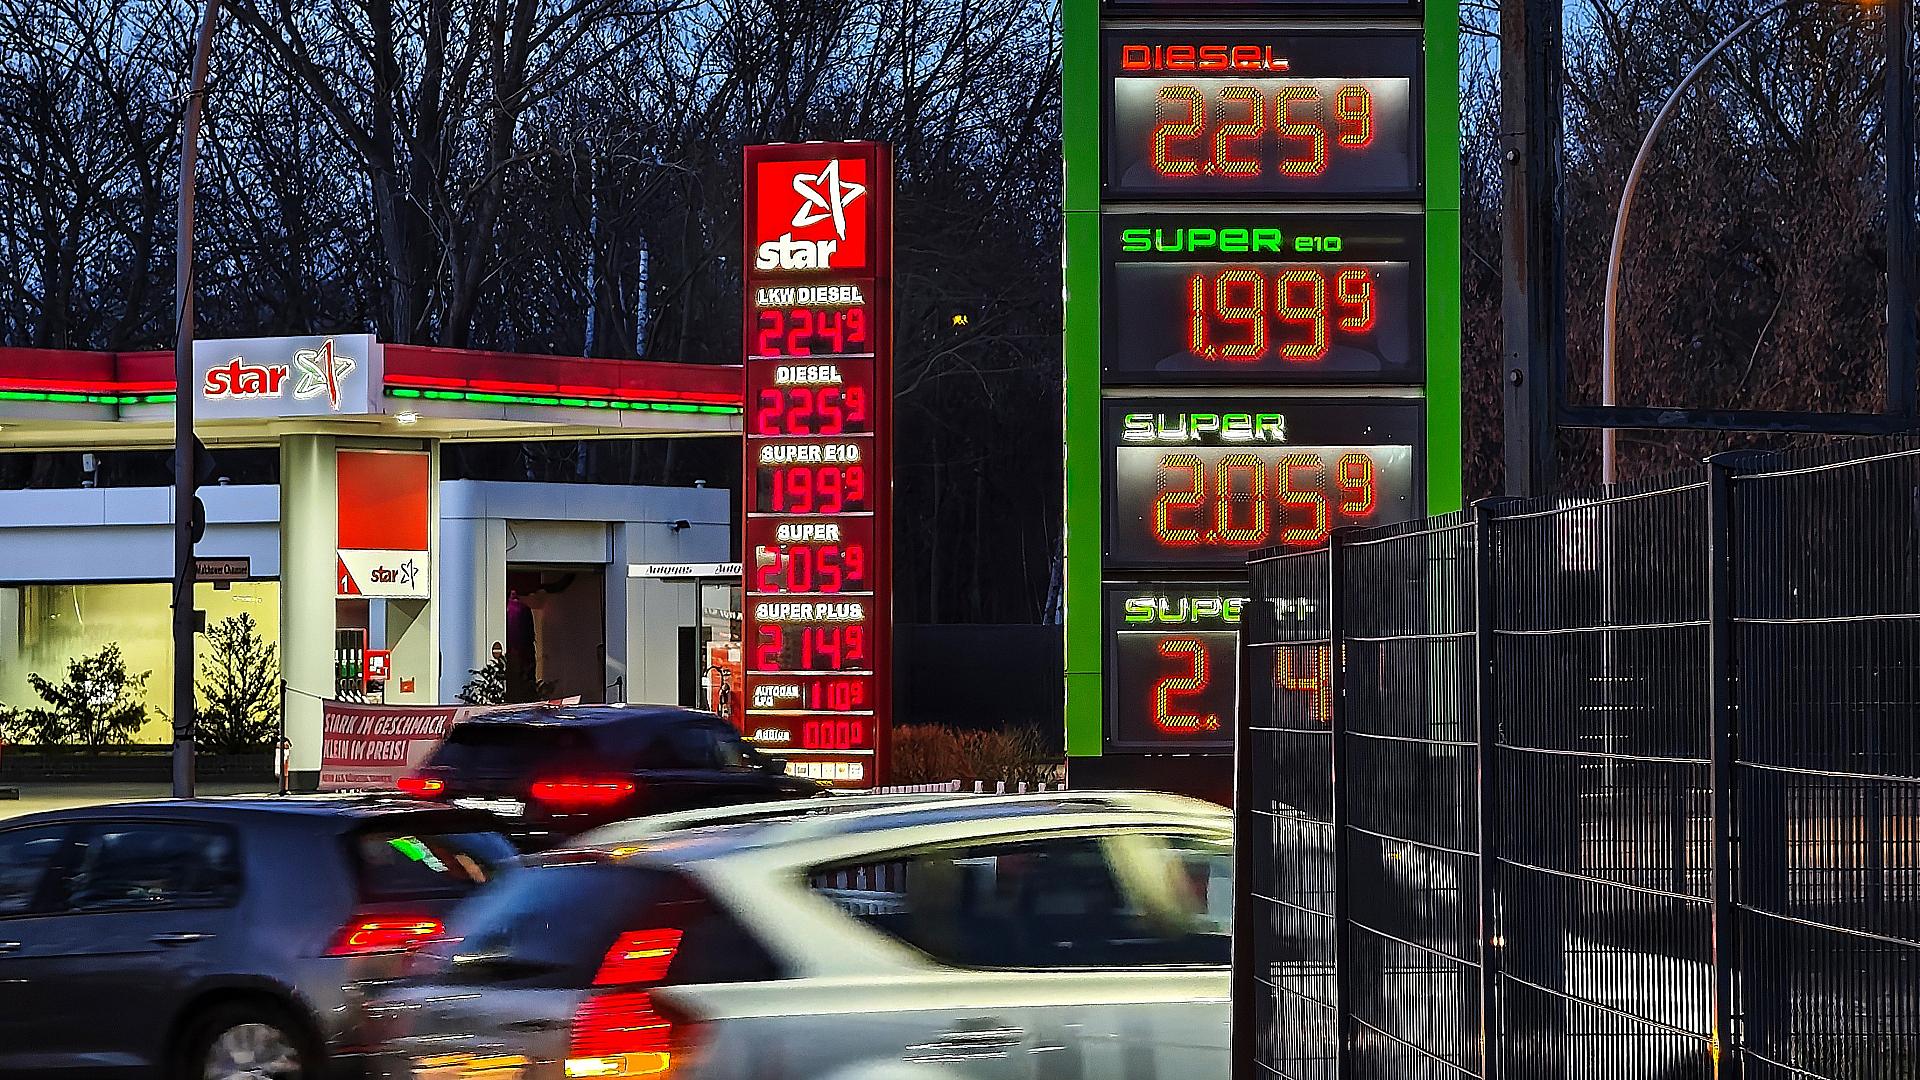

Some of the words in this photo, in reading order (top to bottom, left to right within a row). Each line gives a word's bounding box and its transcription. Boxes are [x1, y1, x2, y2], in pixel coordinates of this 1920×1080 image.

[1122, 228, 1282, 252] SUPER
[755, 232, 837, 270] star
[757, 286, 795, 305] LKW
[797, 285, 864, 305] DIESEL
[203, 356, 289, 399] star
[776, 365, 842, 384] DIESEL
[1123, 413, 1286, 441] SUPER
[760, 444, 823, 463] SUPER
[824, 444, 859, 463] E10
[776, 523, 840, 542] SUPER
[340, 574, 349, 592] 1
[370, 565, 398, 583] star
[756, 602, 813, 621] SUPER
[815, 602, 863, 620] PLUS
[324, 713, 359, 734] STARK
[323, 739, 350, 759] KLEIN
[350, 740, 368, 760] IM
